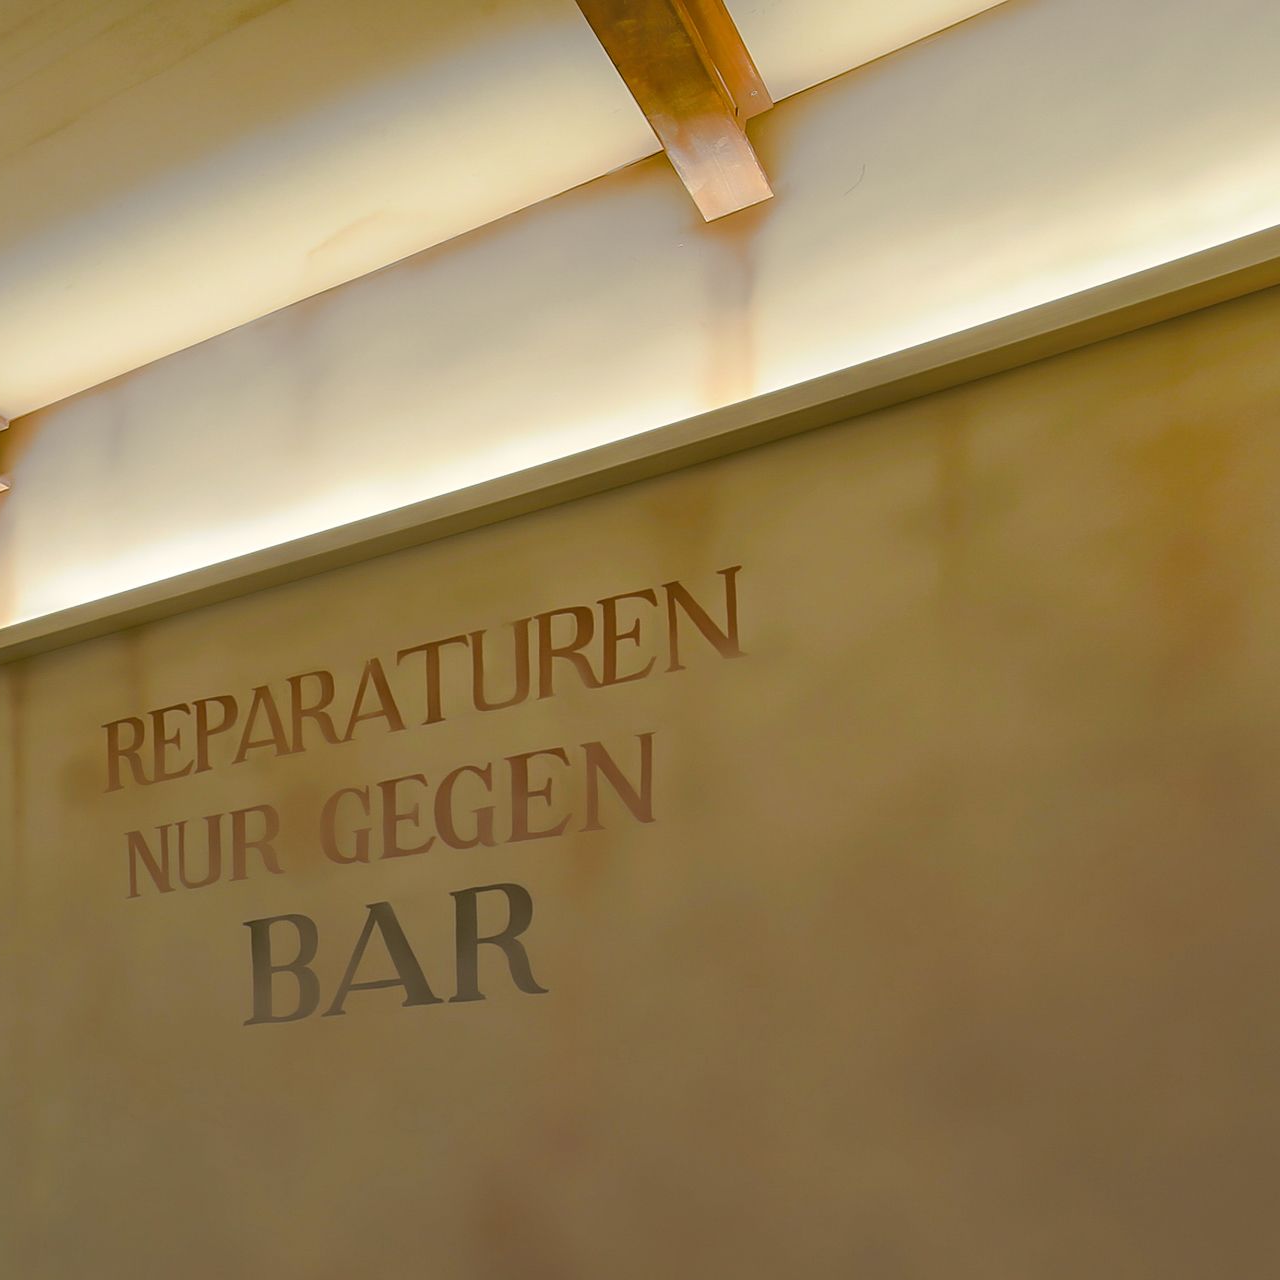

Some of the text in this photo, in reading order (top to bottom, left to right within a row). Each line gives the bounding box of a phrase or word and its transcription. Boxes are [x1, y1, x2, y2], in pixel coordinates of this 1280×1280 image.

[100, 564, 749, 796] REPARATUREN
[124, 731, 657, 899] NUR GEGEN
[242, 881, 550, 1027] BAR
